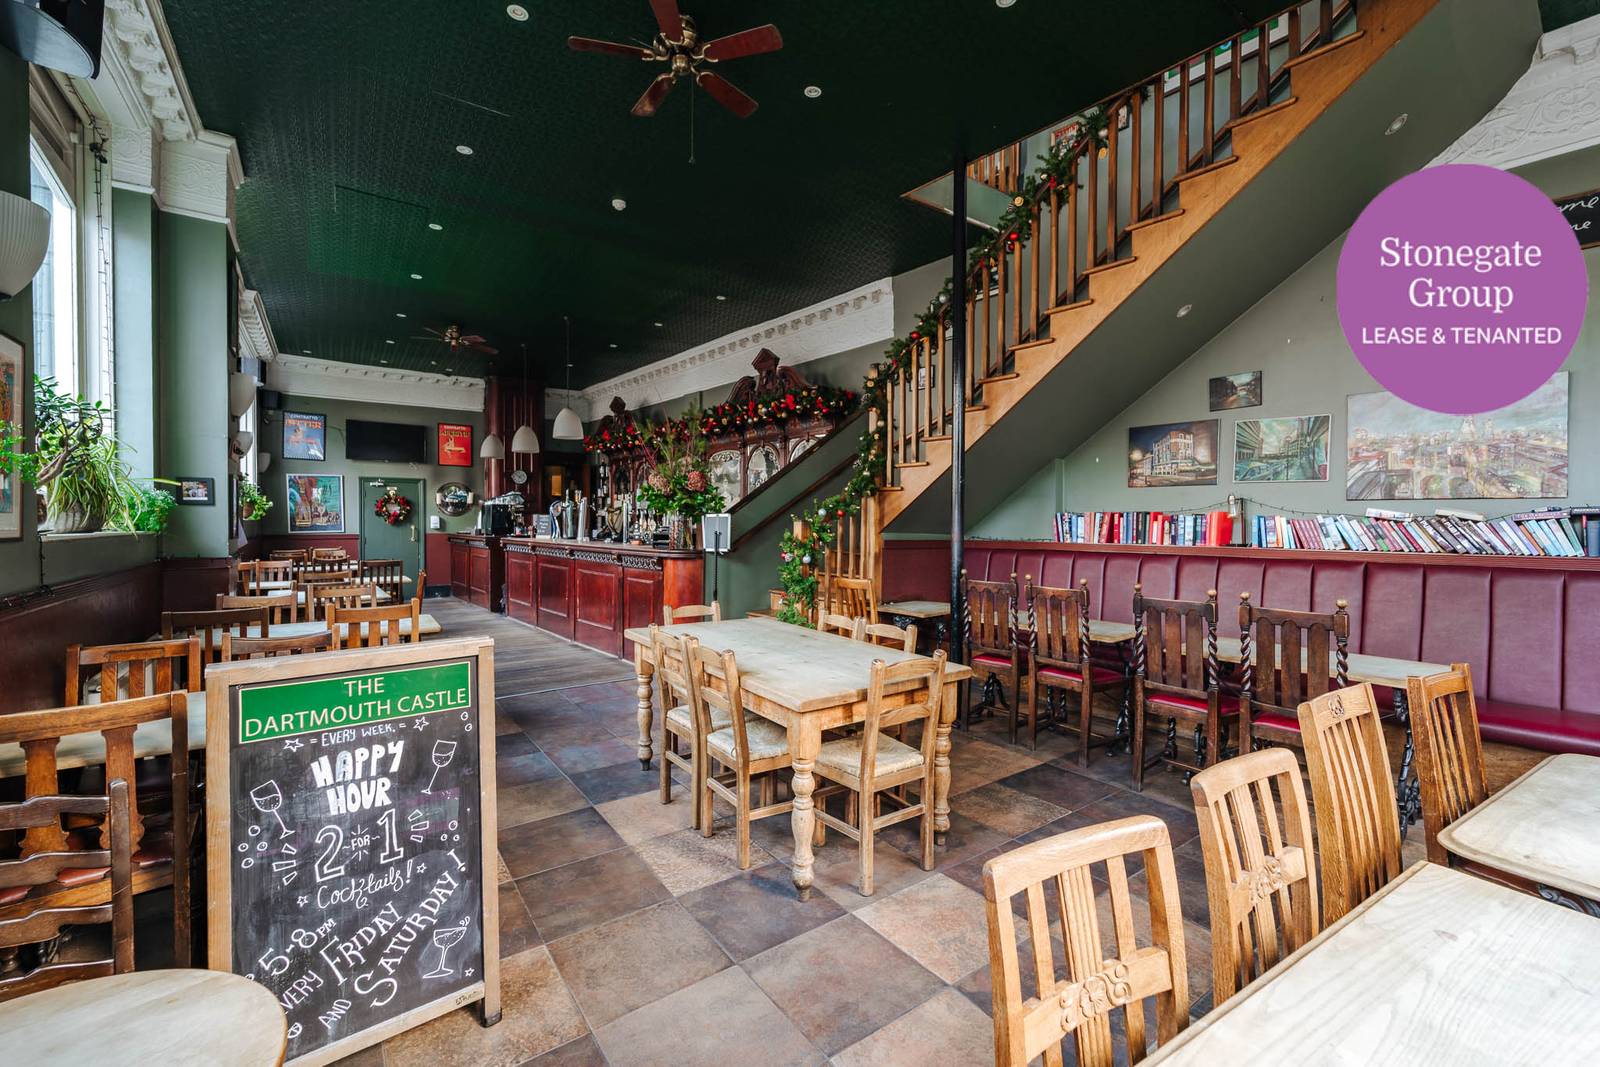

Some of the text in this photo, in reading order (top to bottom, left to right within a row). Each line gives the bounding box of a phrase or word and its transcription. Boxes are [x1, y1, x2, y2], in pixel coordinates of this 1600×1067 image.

[344, 677, 385, 697] THE
[245, 688, 466, 738] DARTMOUTH CASTLE
[321, 729, 356, 747] EVERY
[310, 740, 405, 788] HAPPY
[326, 777, 393, 816] HOUR
[314, 808, 404, 883] 2 FOR 1
[317, 859, 413, 910] Cocktails!
[279, 901, 403, 1015] VERY FRIDAY
[318, 998, 352, 1030] AND
